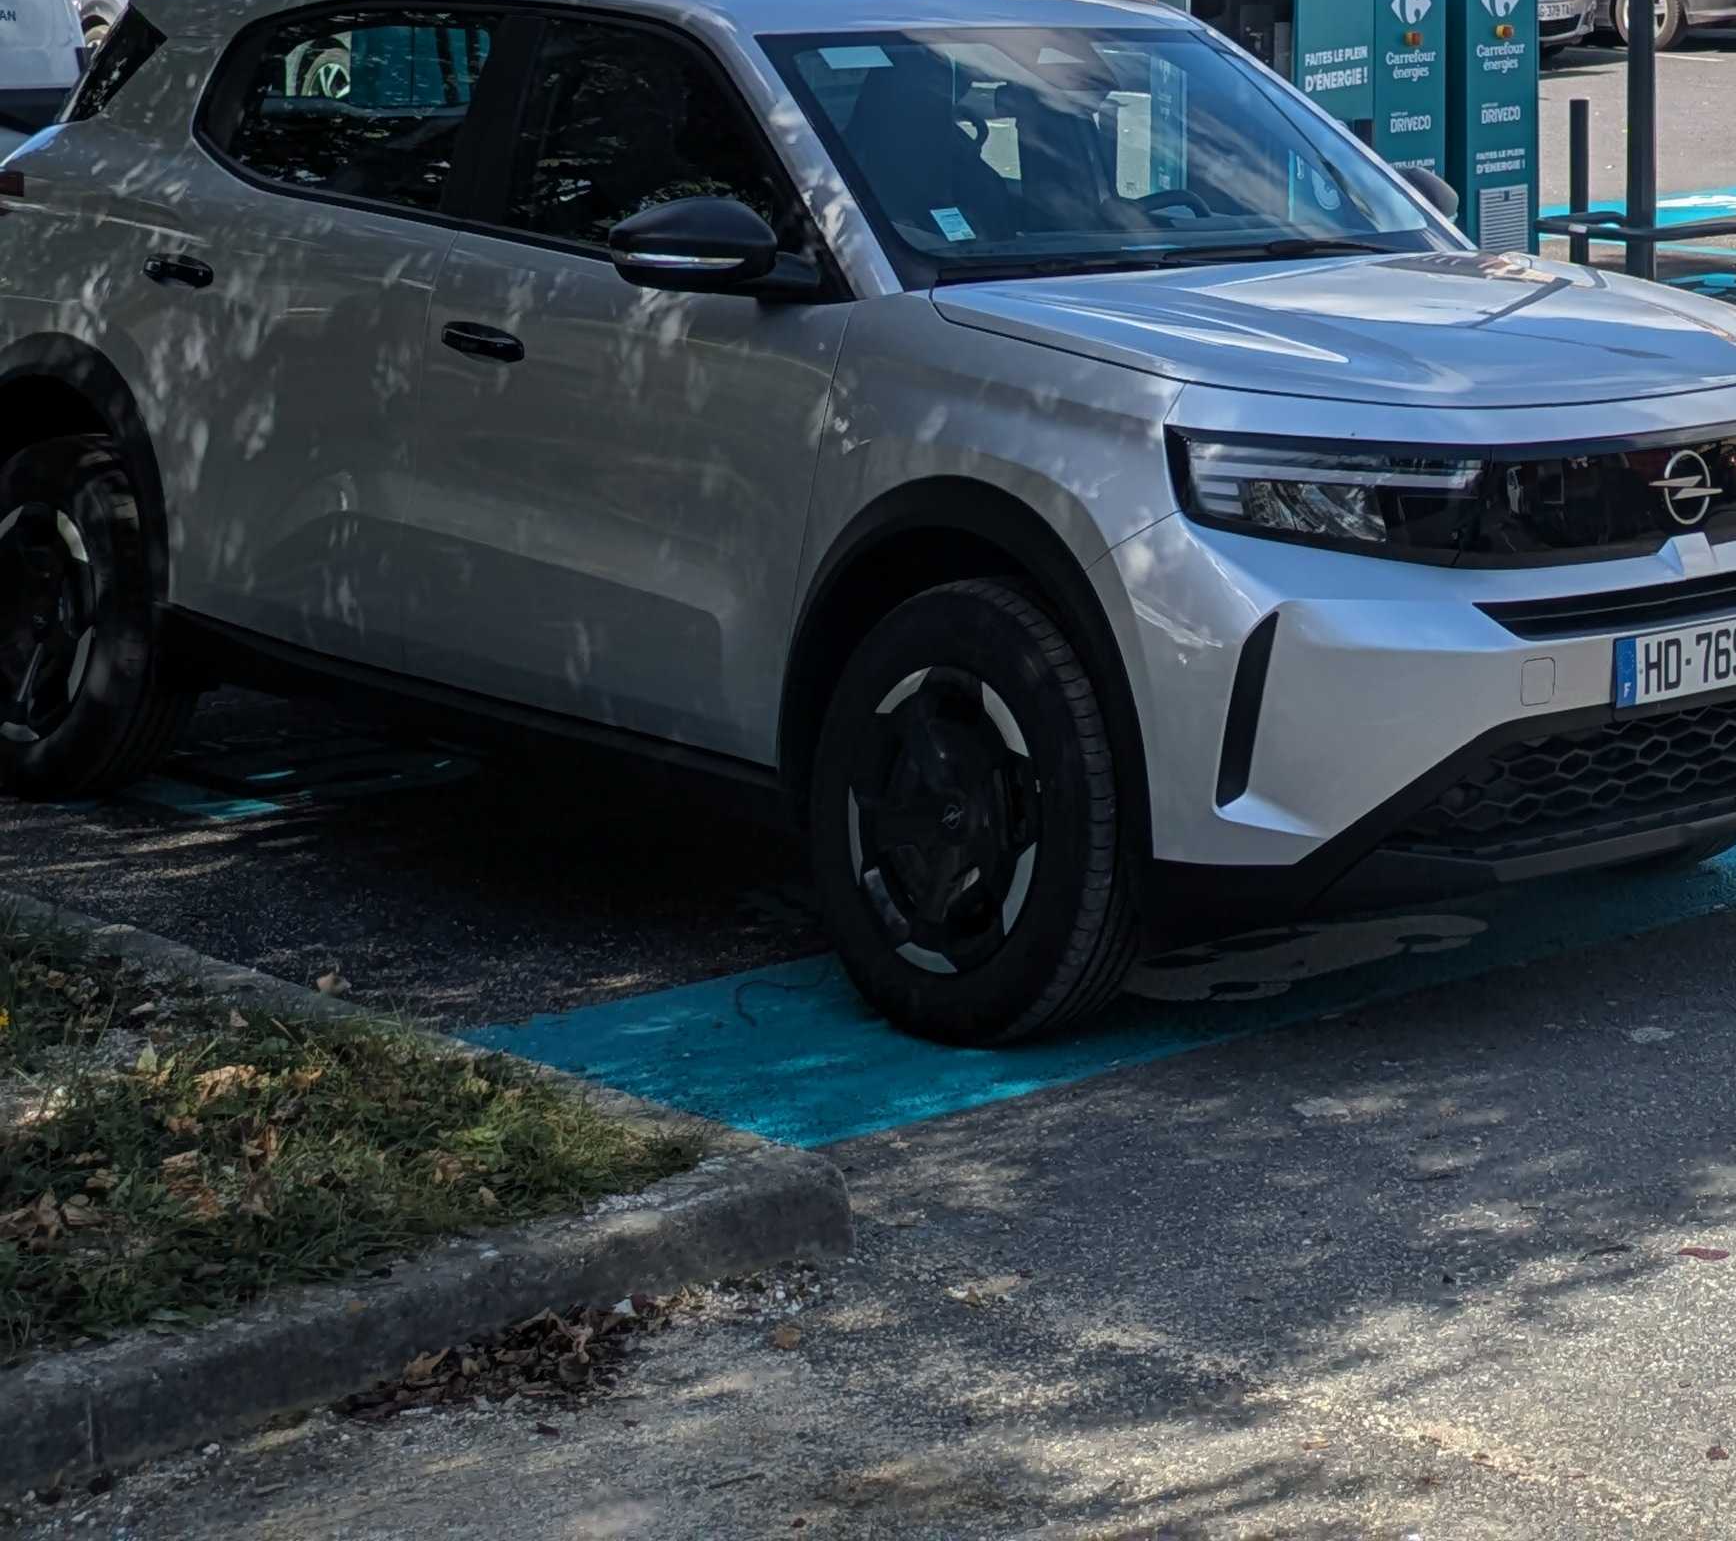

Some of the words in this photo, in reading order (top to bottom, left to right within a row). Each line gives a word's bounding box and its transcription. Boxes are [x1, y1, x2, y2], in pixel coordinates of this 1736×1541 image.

[1305, 50, 1332, 66] FAITES
[1334, 49, 1344, 62] LE
[1345, 46, 1368, 59] PLEIN
[1386, 50, 1436, 65] Carrefour
[1476, 42, 1525, 57] Carrefour
[1393, 65, 1429, 81] énergies
[1483, 57, 1518, 73] énergies
[1305, 69, 1362, 92] D'ÉNERGIE
[1481, 106, 1520, 124] DRIVECO
[1390, 115, 1431, 133] DRIVECO
[1623, 682, 1631, 698] F
